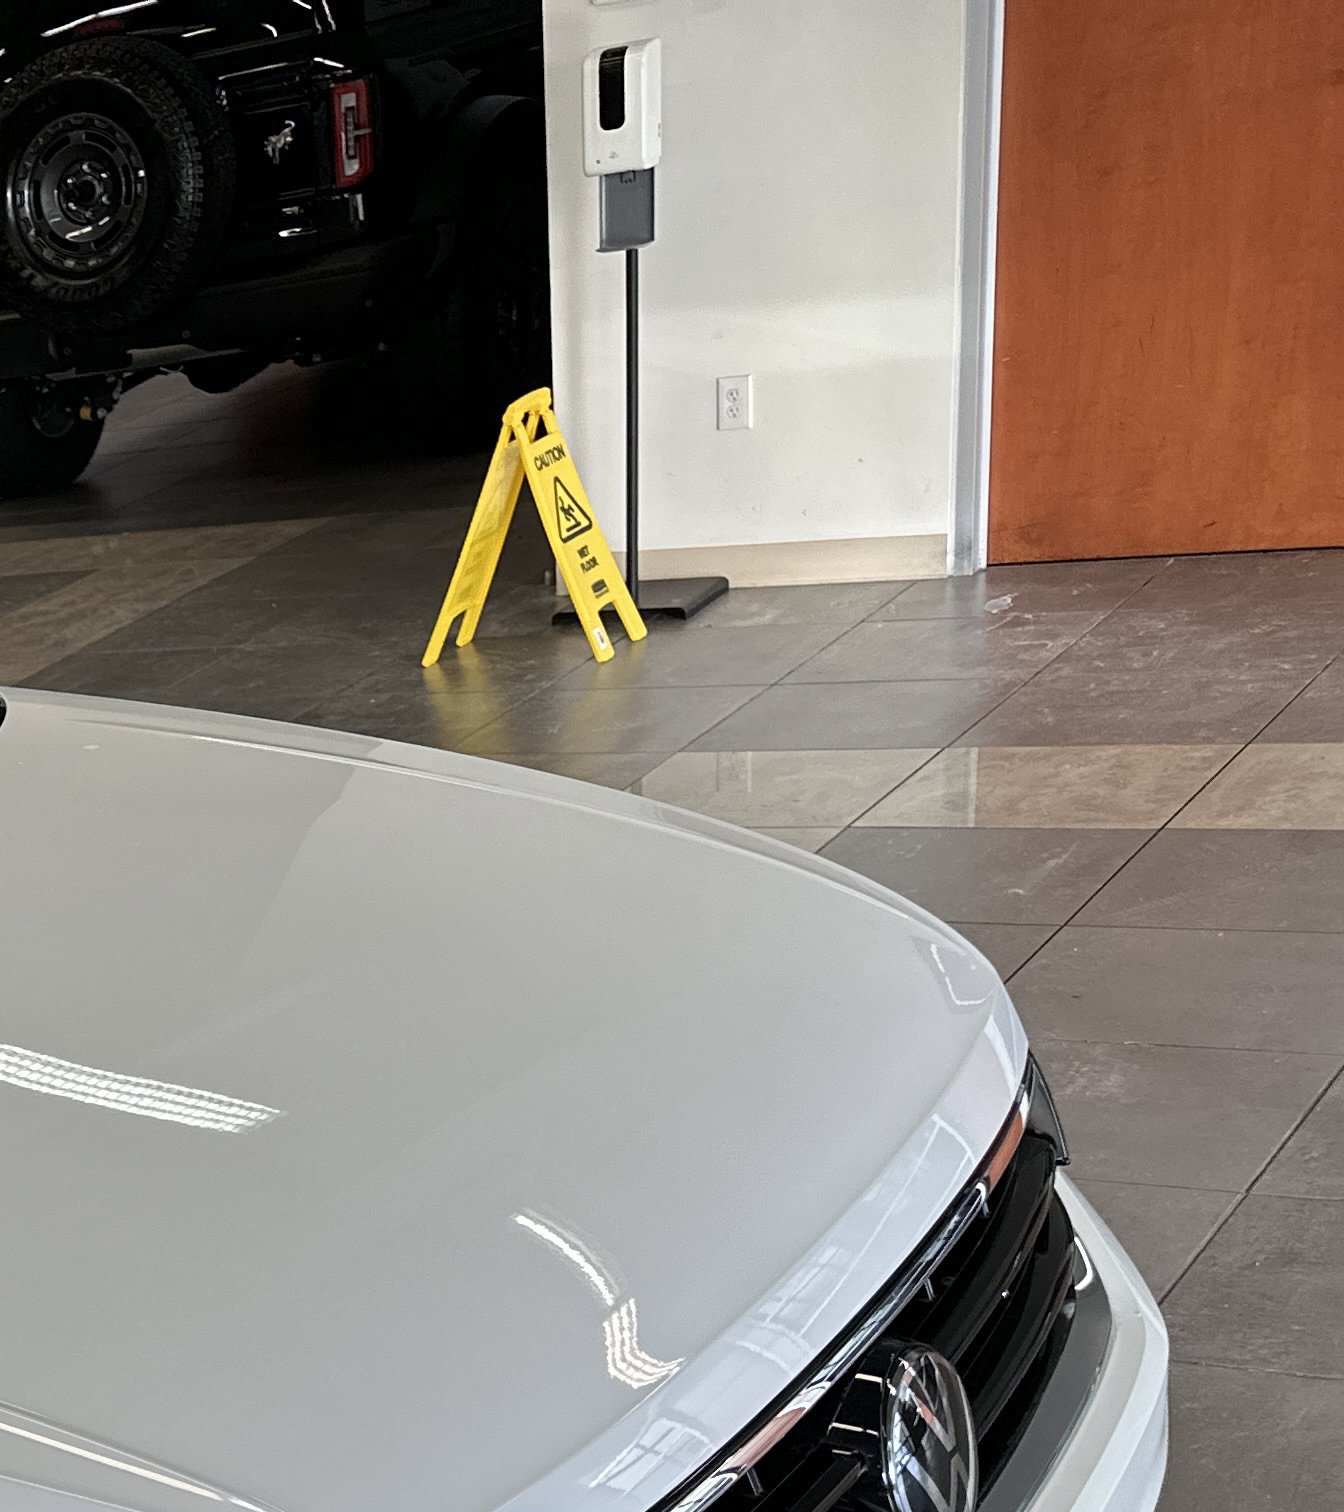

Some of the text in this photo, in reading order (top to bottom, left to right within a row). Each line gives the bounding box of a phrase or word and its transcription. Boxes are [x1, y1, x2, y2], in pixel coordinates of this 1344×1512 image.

[533, 442, 567, 472] CAUTION
[577, 544, 590, 560] WET
[580, 556, 600, 574] FLOOR
